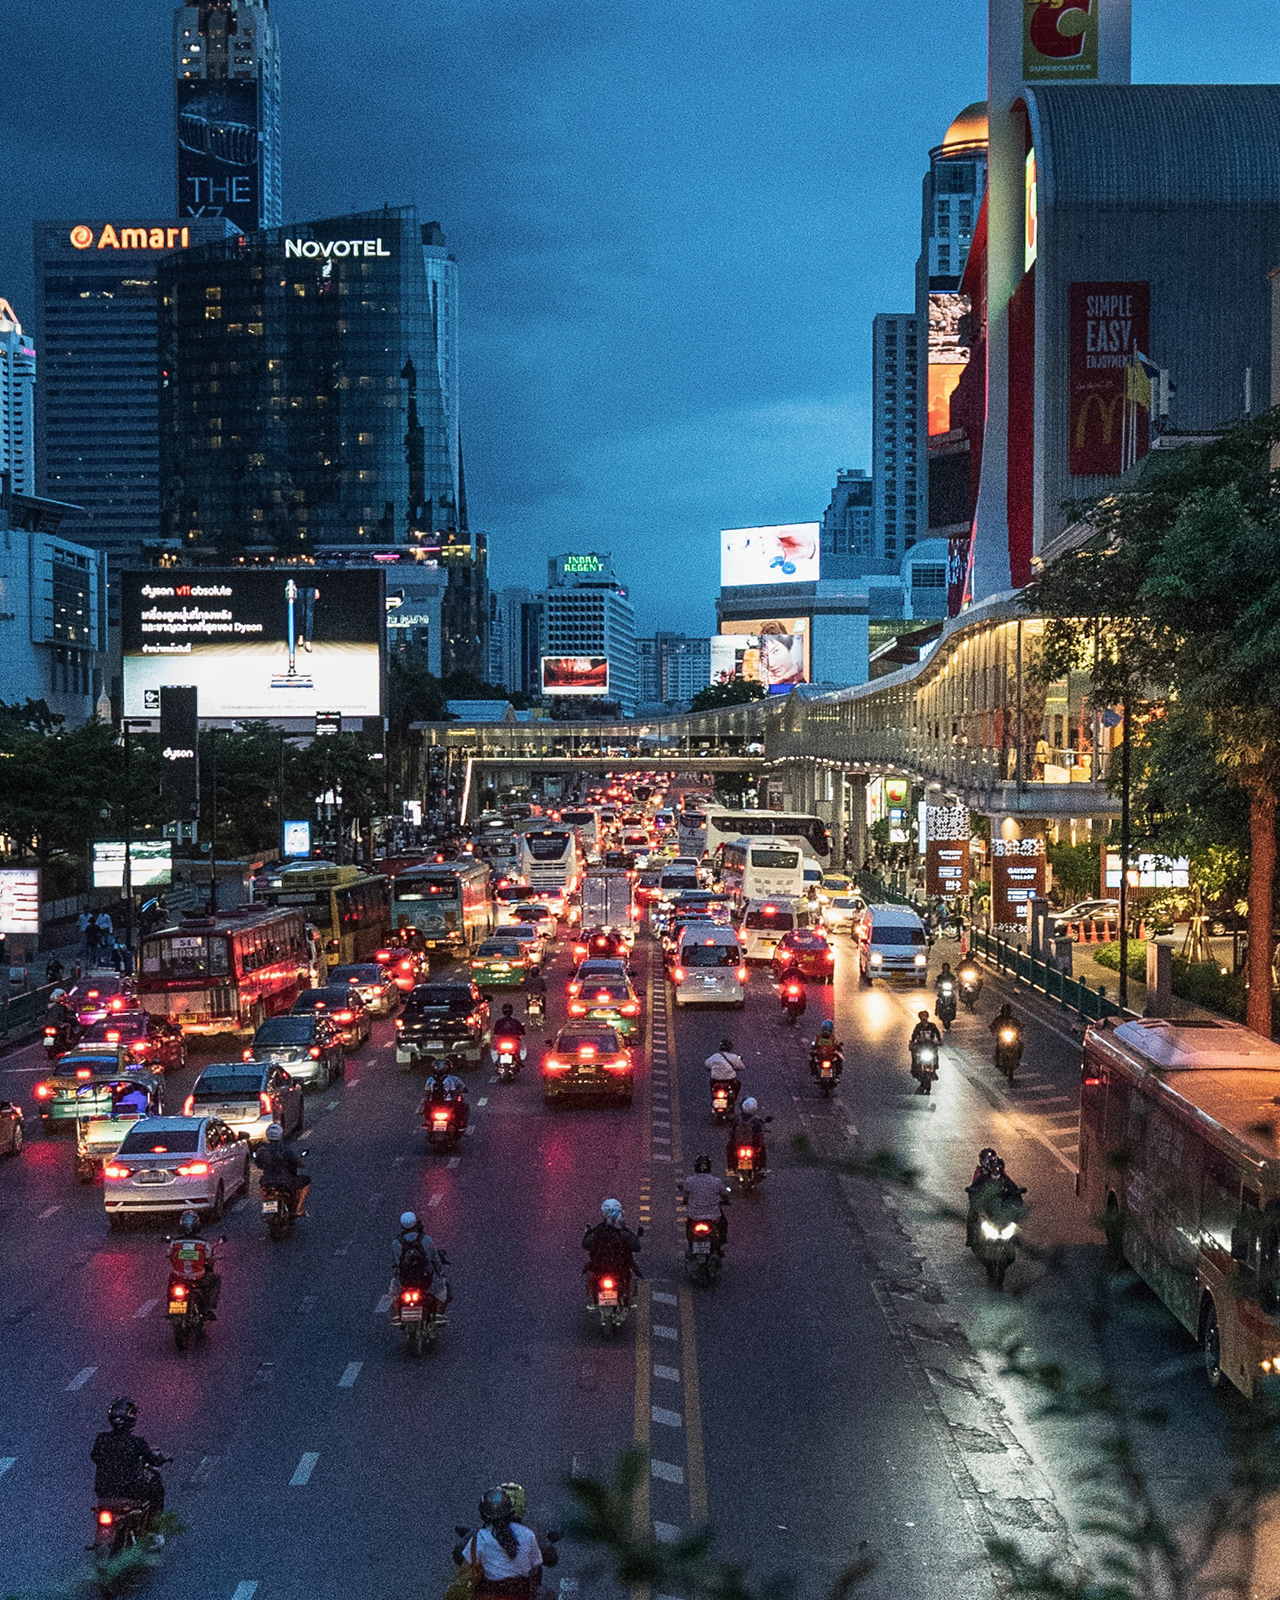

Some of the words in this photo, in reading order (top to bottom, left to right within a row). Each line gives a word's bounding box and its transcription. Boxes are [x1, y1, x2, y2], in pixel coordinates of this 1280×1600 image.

[187, 177, 250, 203] THE
[97, 224, 189, 249] Amari
[284, 238, 391, 258] NOVOTEL
[1086, 295, 1133, 318] SIMPLE
[1086, 320, 1132, 352] EASY
[563, 564, 604, 572] REGENT
[568, 556, 599, 564] INDRA
[141, 585, 175, 598] dyson
[175, 585, 191, 596] v11
[190, 585, 232, 596] absolute
[234, 622, 263, 633] Dyson
[163, 747, 194, 761] dyson
